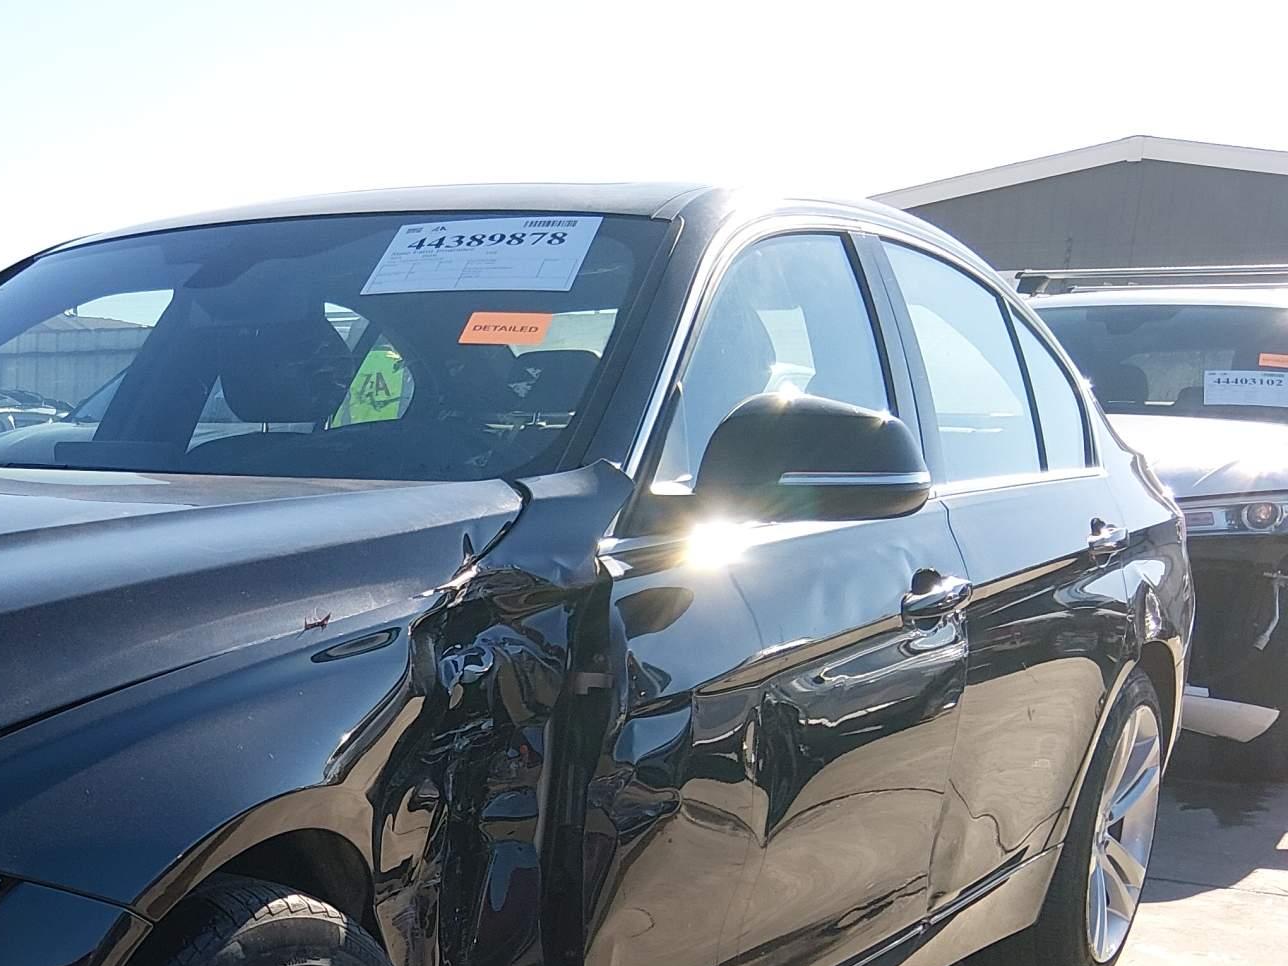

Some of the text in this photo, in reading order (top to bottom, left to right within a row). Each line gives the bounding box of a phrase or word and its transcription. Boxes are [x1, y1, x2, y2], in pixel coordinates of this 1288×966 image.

[407, 231, 568, 250] 44389878
[472, 324, 539, 333] DETAILED
[1213, 377, 1284, 387] 44403102
